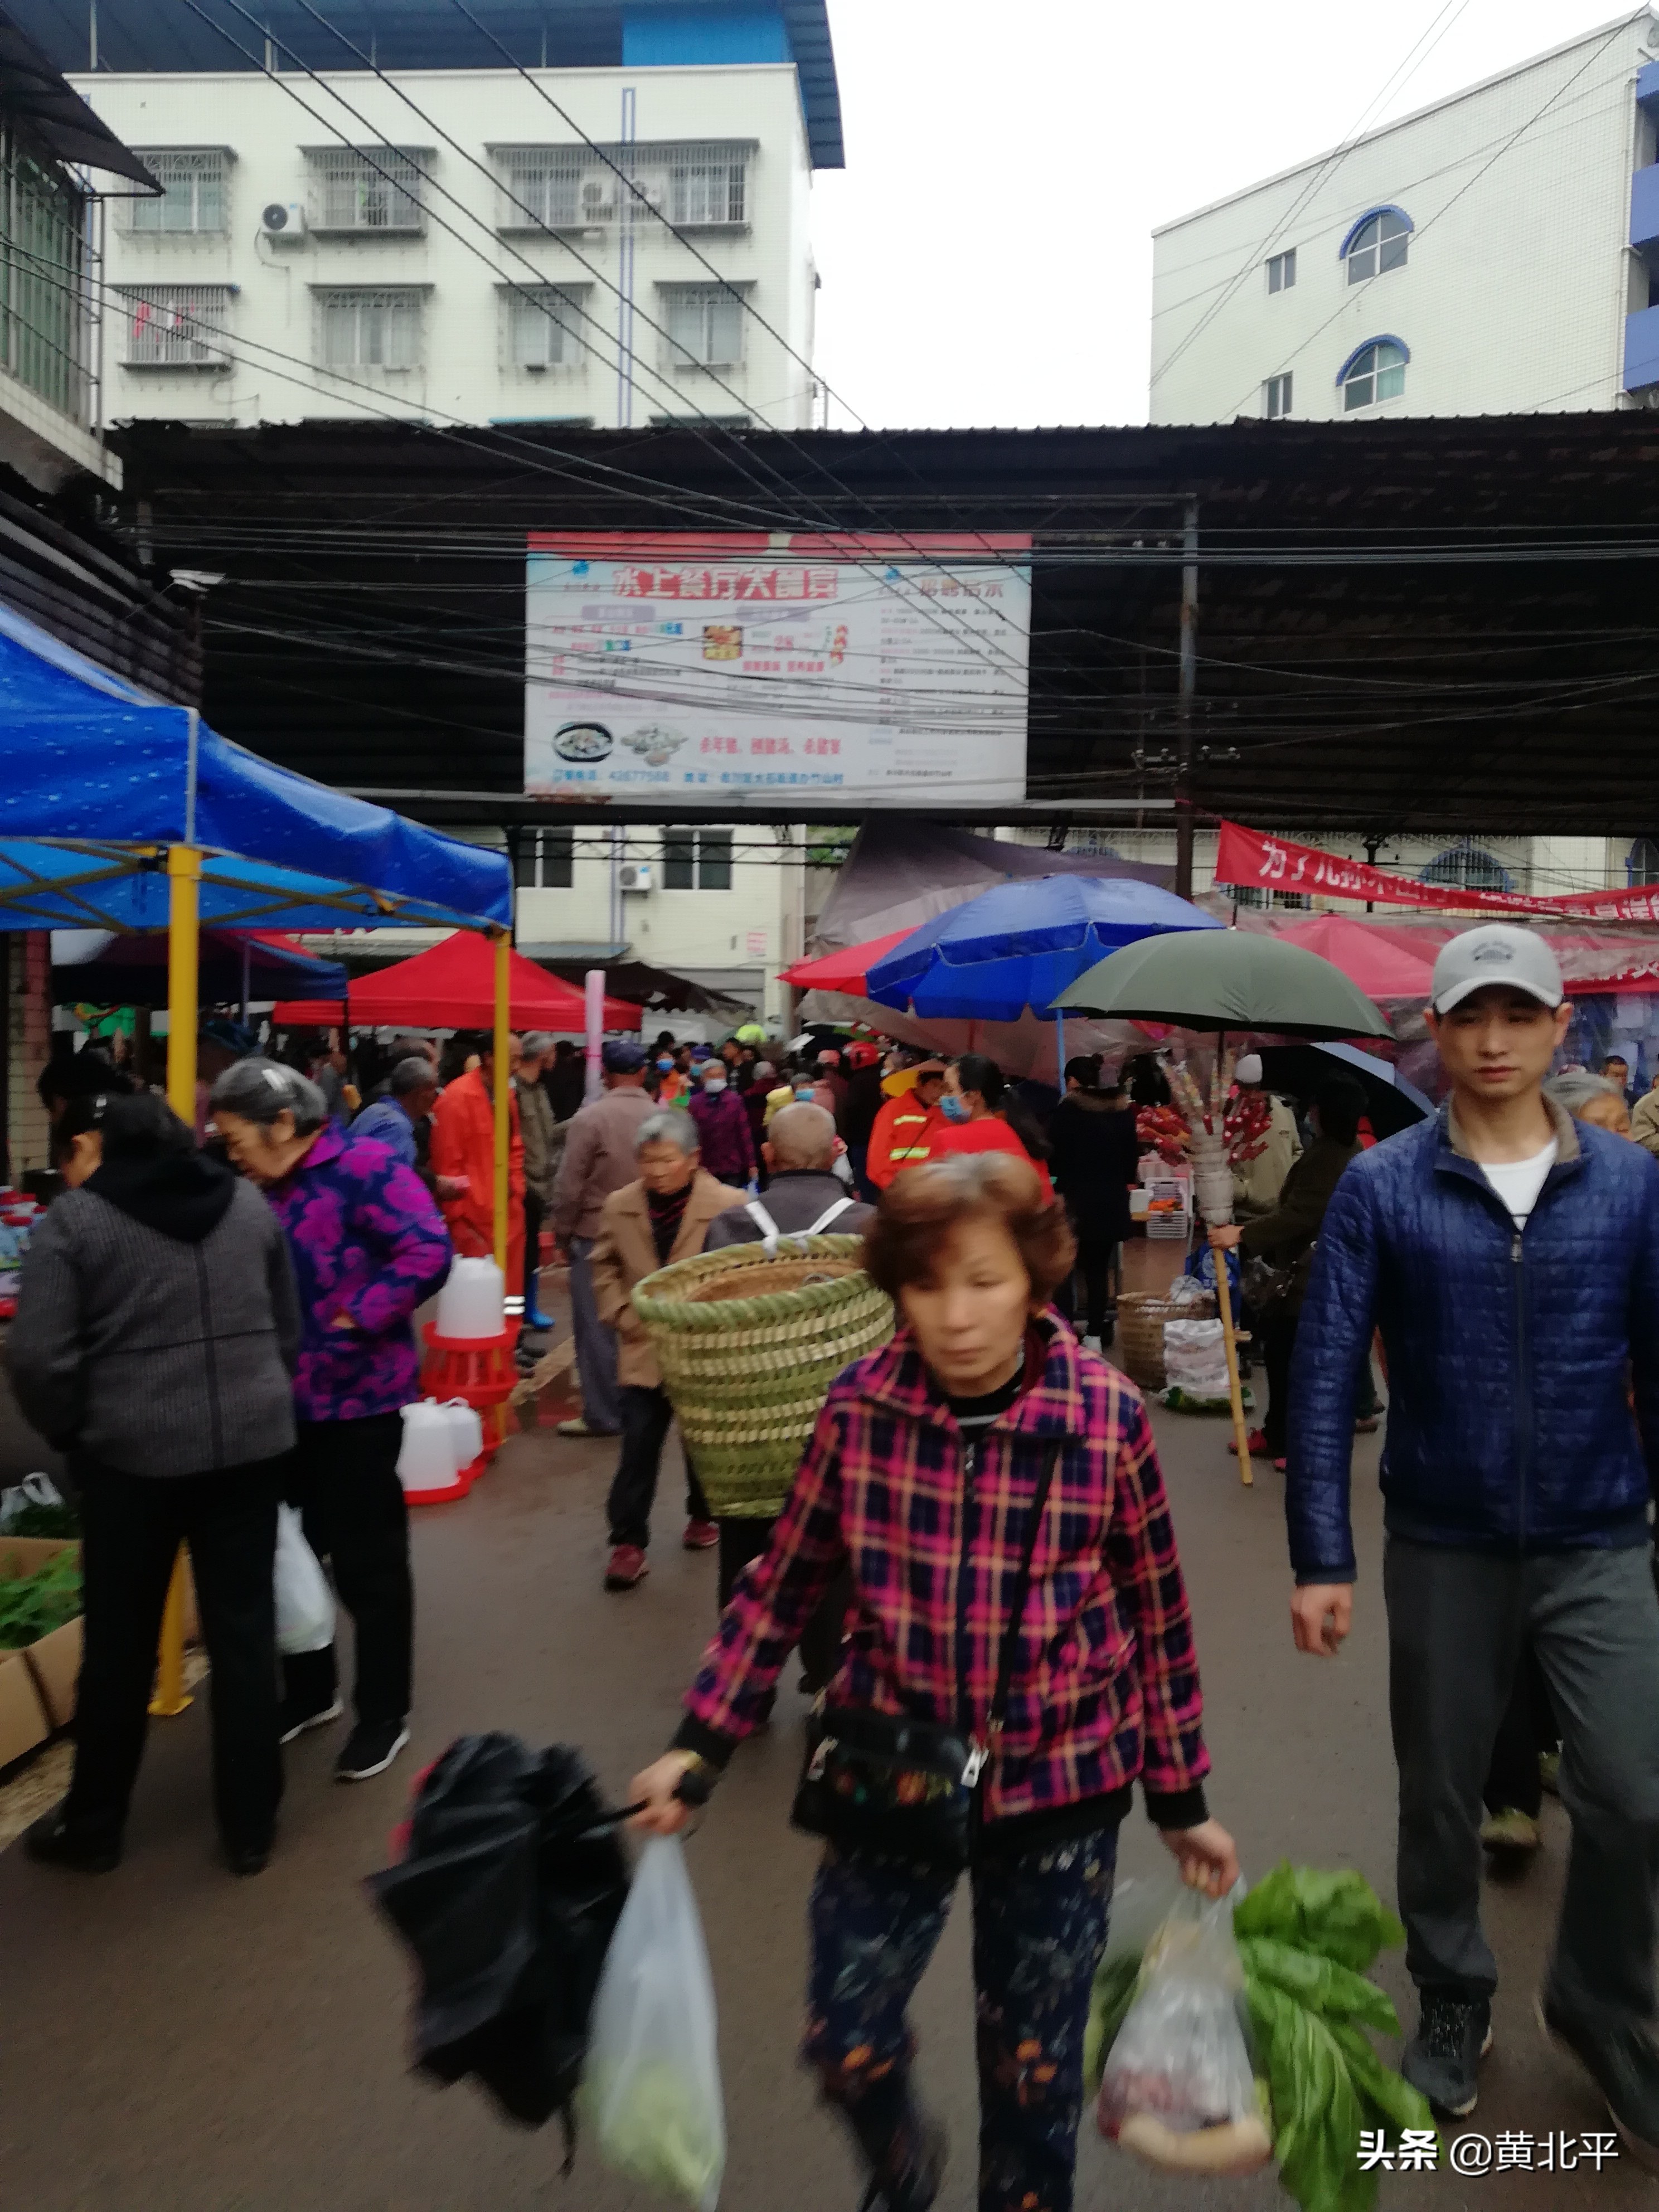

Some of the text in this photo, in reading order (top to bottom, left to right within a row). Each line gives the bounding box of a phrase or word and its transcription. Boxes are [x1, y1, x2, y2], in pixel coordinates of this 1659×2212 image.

[613, 566, 839, 600] 水上餐厅大酬宾
